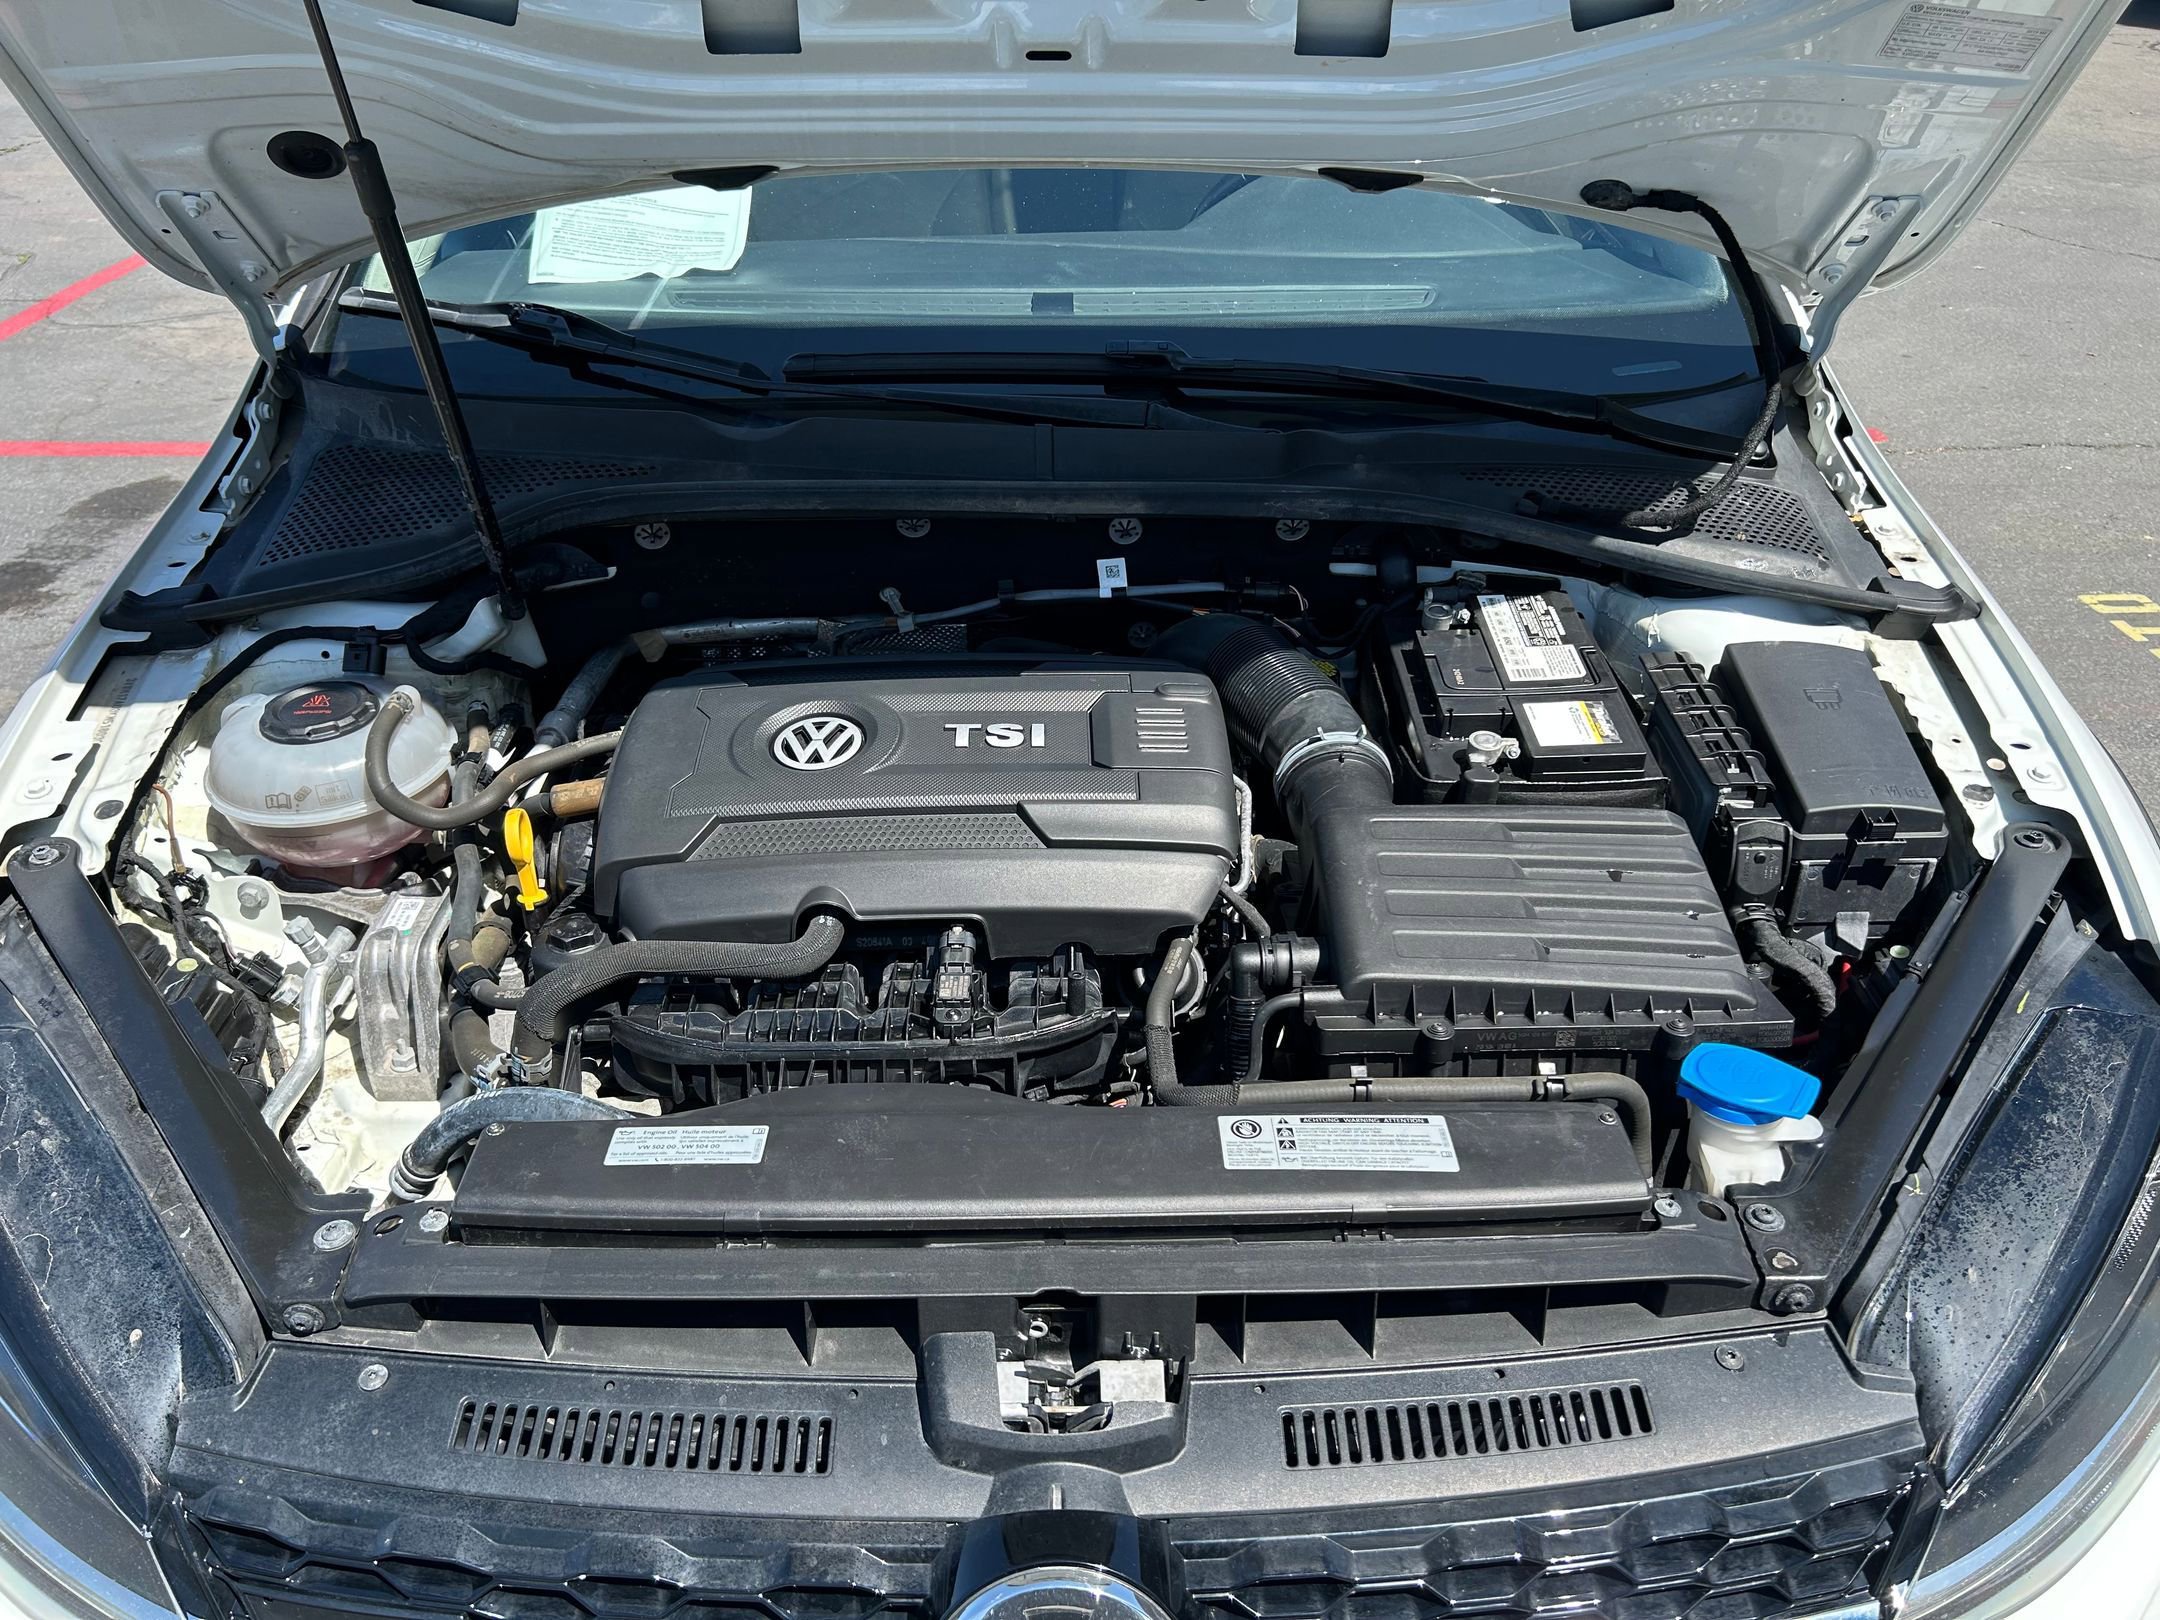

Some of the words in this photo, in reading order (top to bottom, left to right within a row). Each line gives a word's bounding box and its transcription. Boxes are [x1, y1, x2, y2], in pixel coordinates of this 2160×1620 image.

[944, 722, 1047, 749] TSI
[1477, 1032, 1496, 1041] VW
[1498, 1031, 1517, 1041] AG
